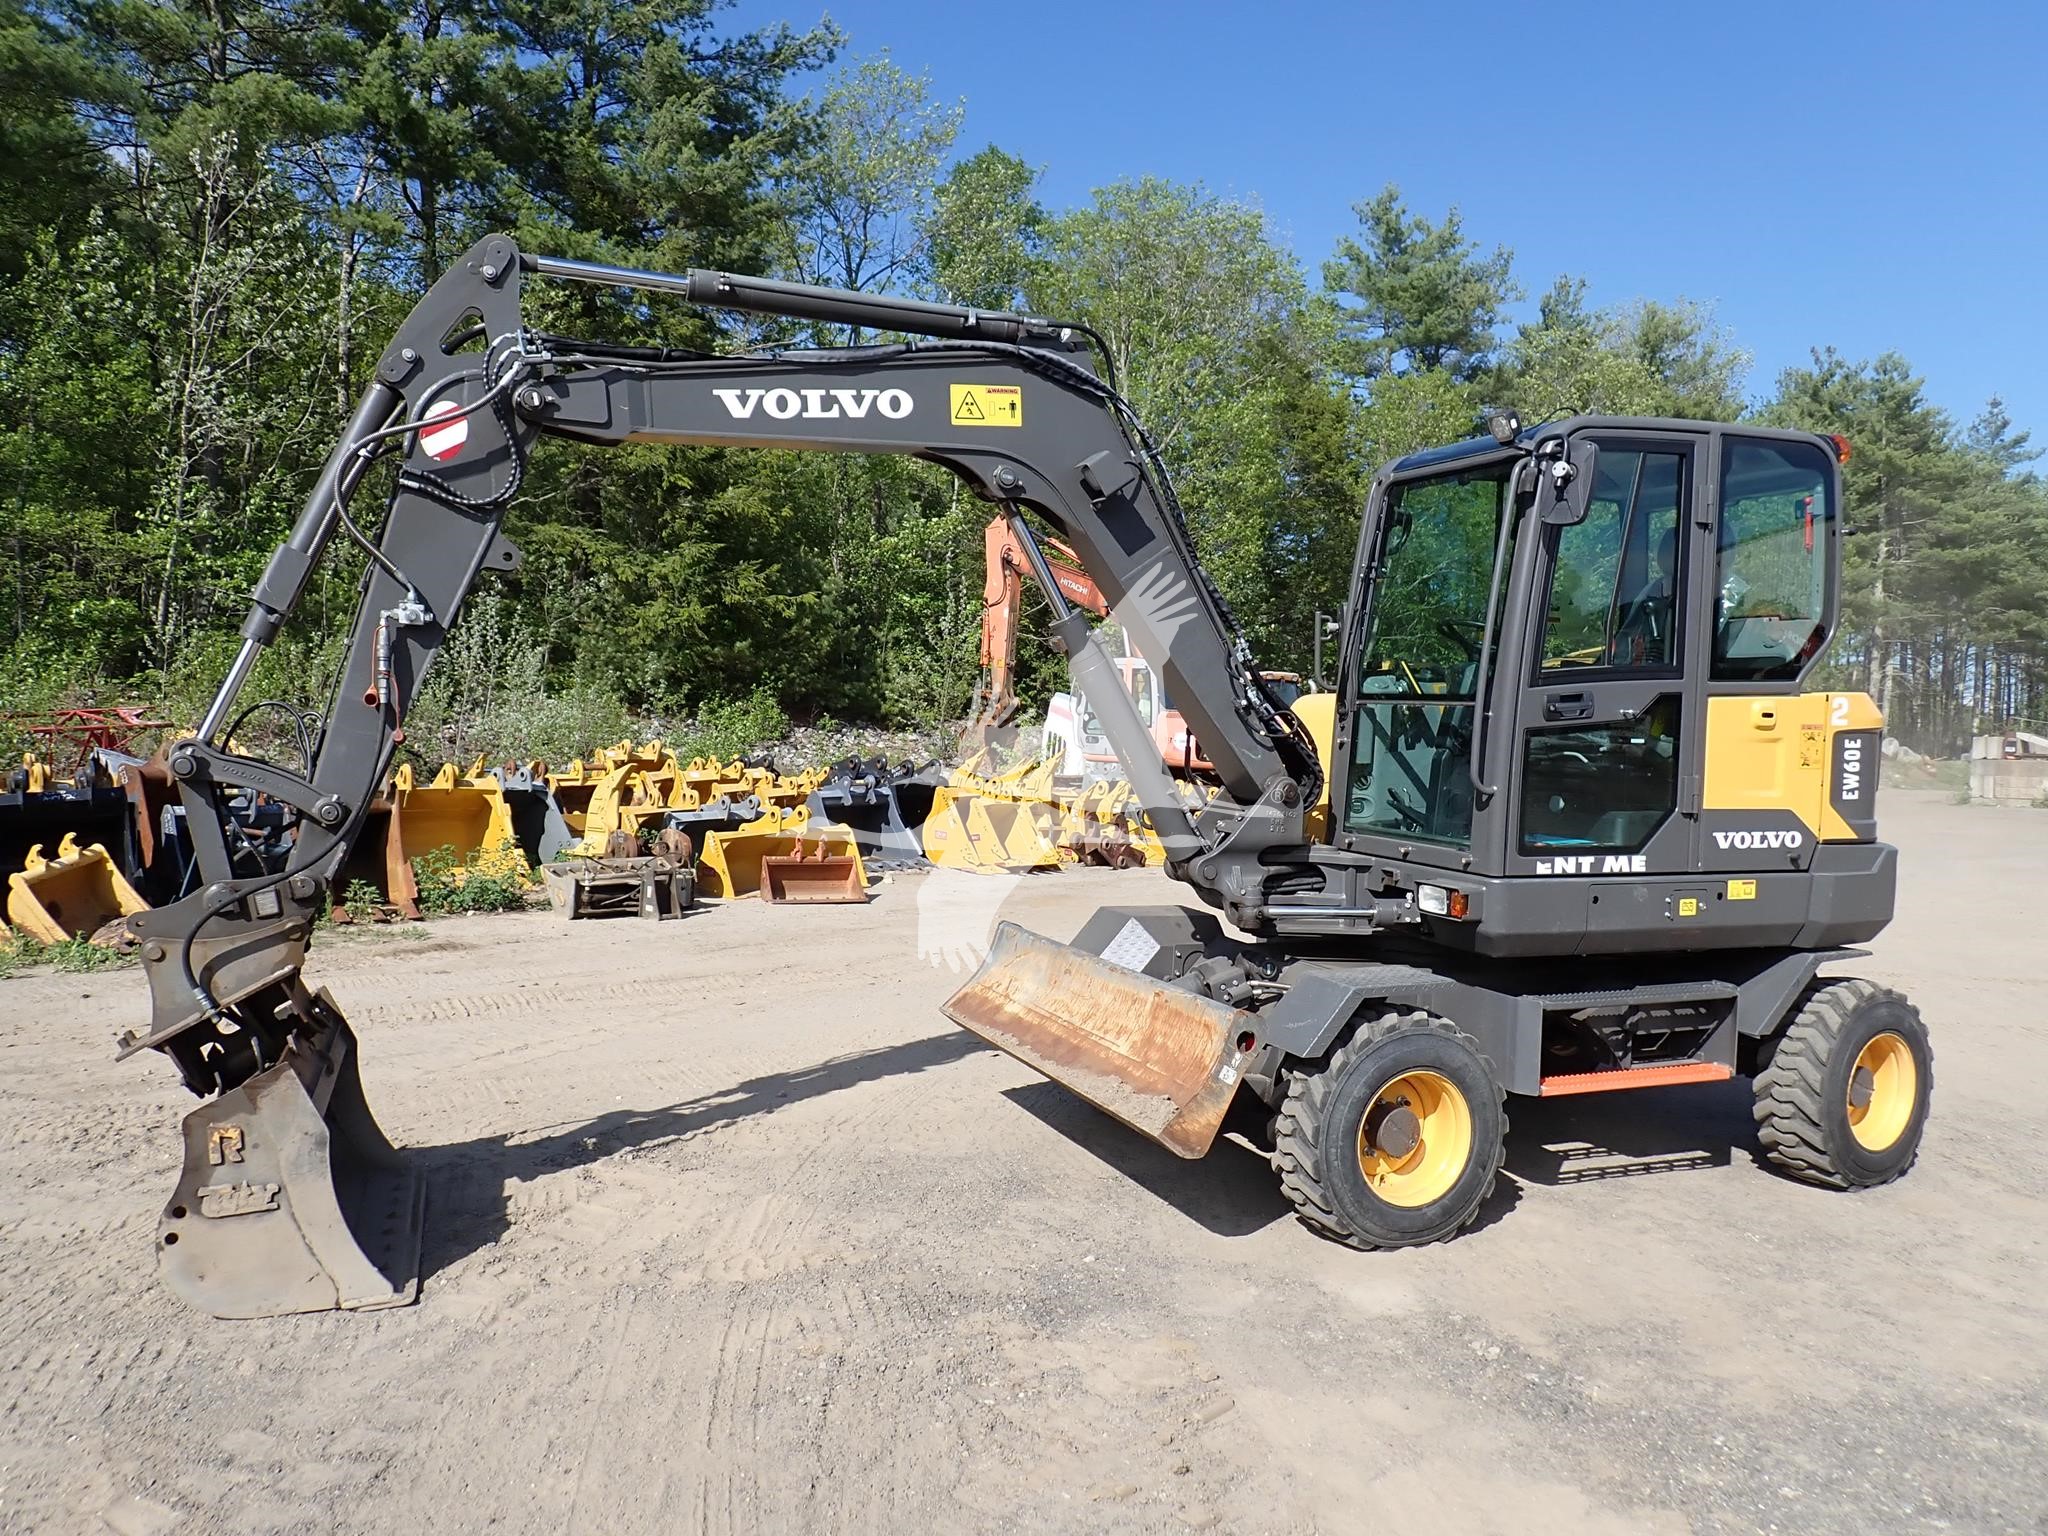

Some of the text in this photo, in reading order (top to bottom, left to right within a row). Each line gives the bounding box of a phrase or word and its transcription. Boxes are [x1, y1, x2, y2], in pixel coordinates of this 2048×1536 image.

[712, 388, 914, 420] VOLVO
[1060, 577, 1088, 596] HITACHI
[1831, 697, 1849, 727] 2
[1842, 738, 1862, 801] EW60E
[1712, 830, 1802, 850] VOLVO
[1602, 855, 1647, 873] ME
